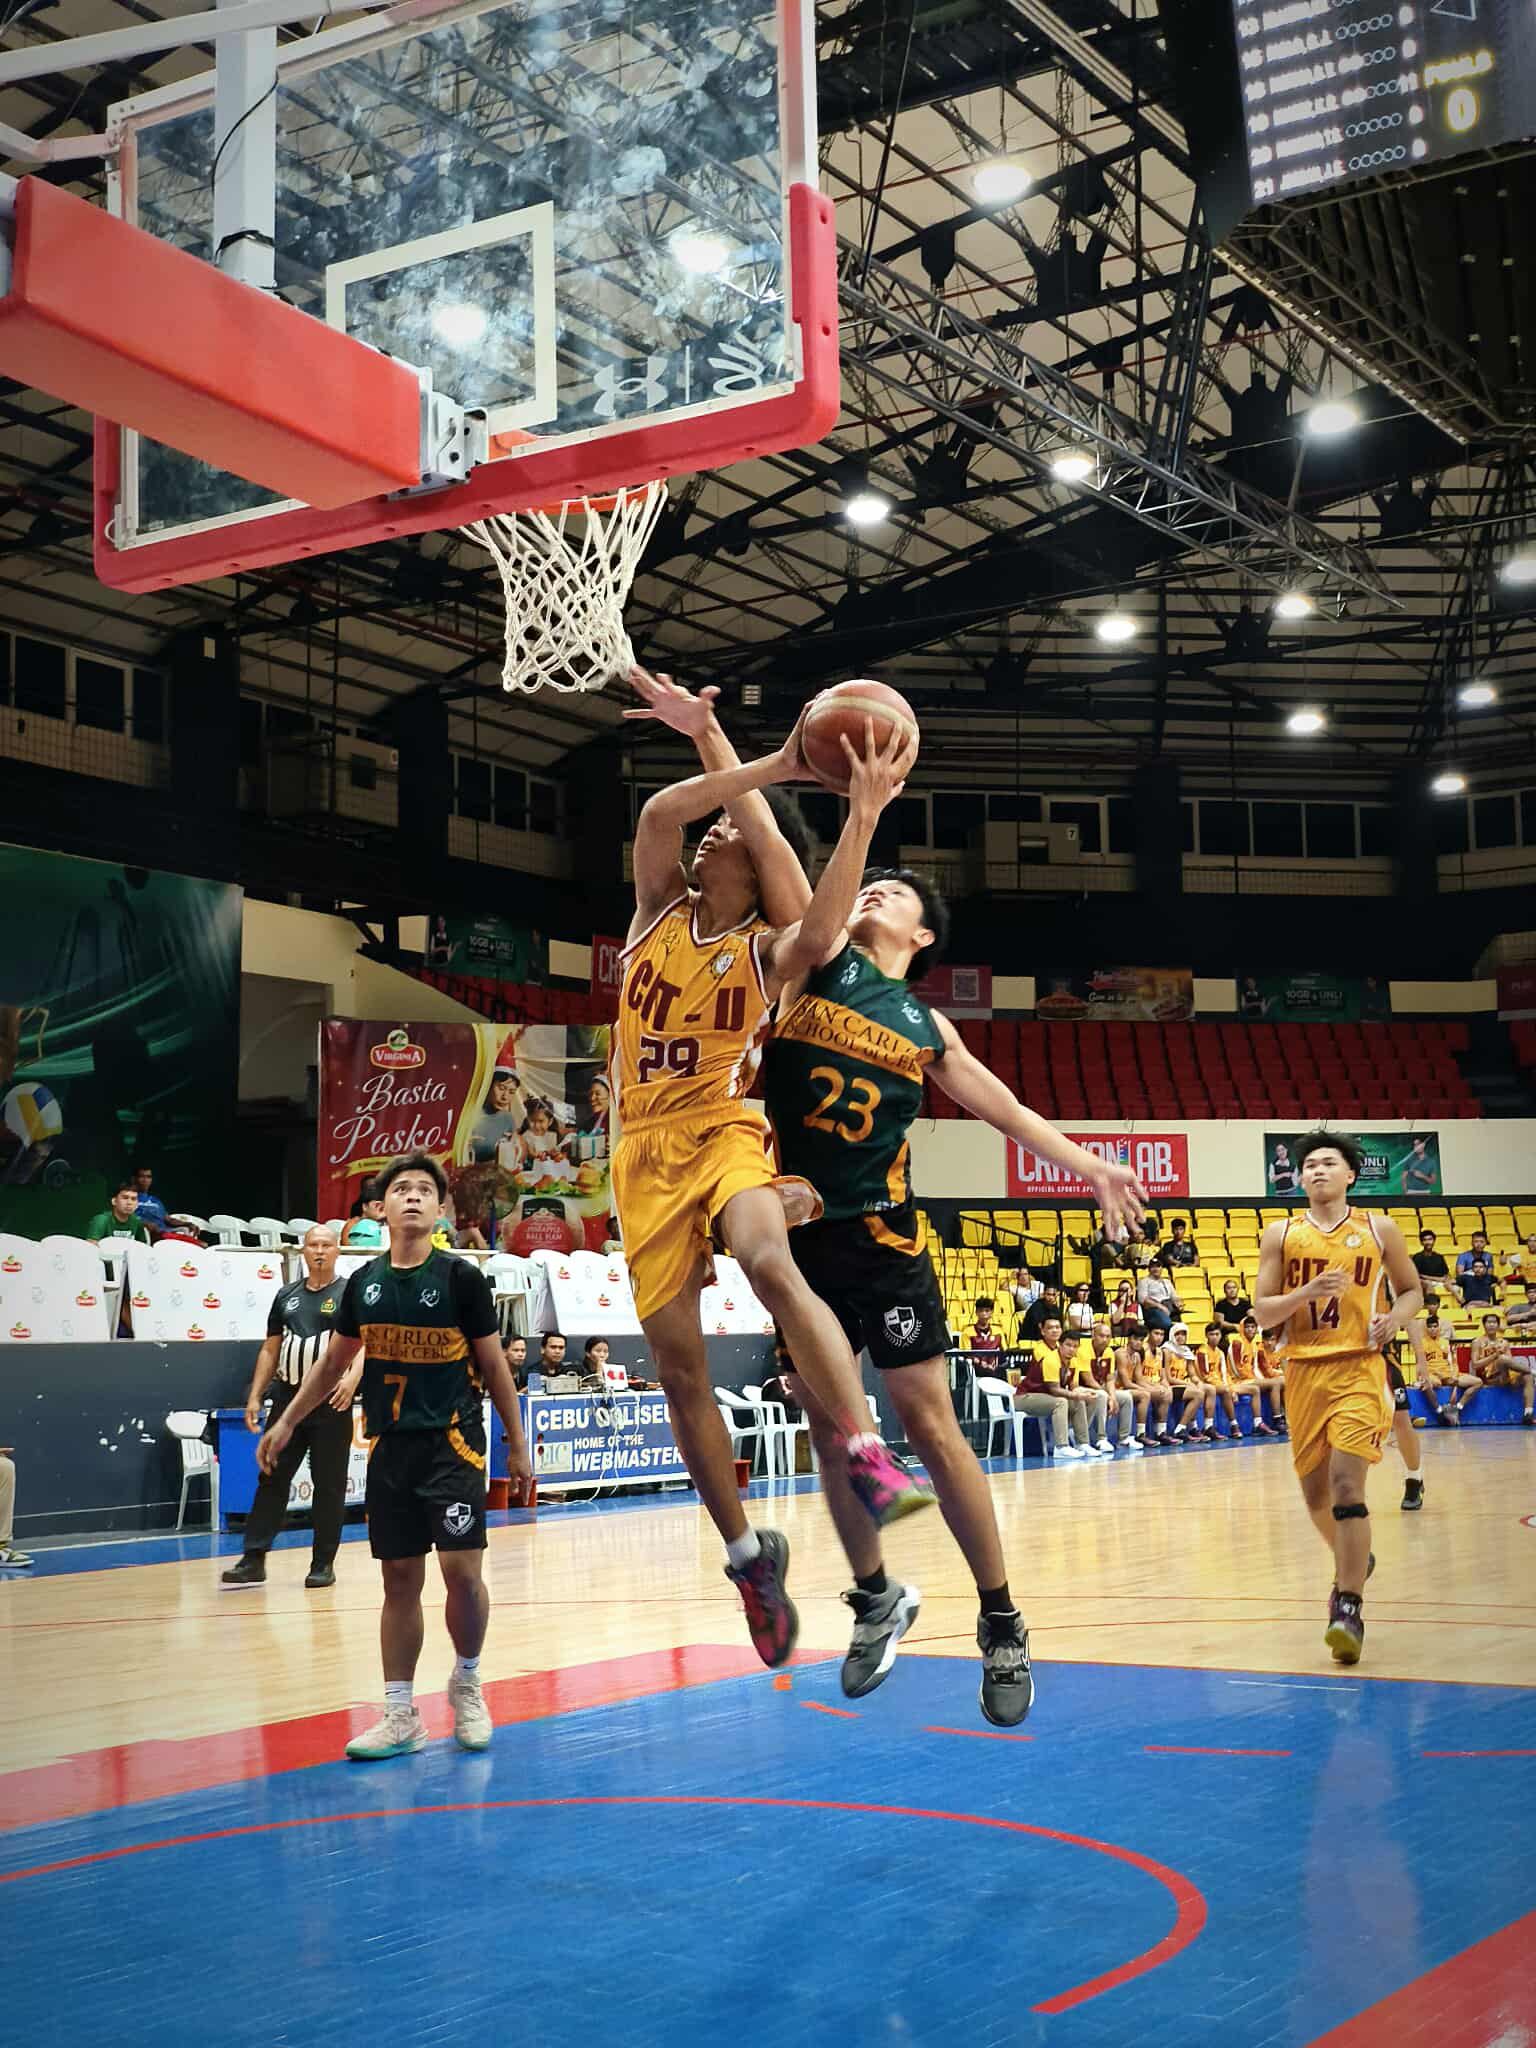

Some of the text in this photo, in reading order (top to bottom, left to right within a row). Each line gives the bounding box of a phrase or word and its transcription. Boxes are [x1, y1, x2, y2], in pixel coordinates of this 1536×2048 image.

[1446, 89, 1479, 133] 0
[375, 1050, 421, 1063] VIRGINIA
[638, 1035, 700, 1084] 29
[355, 1071, 448, 1114] Basta
[803, 1066, 882, 1143] 23
[329, 1109, 454, 1164] Pasko!
[1308, 1296, 1340, 1330] 14
[384, 1374, 408, 1423] 7
[536, 1407, 590, 1431] CEBU
[574, 1434, 645, 1450] HOME OF THE
